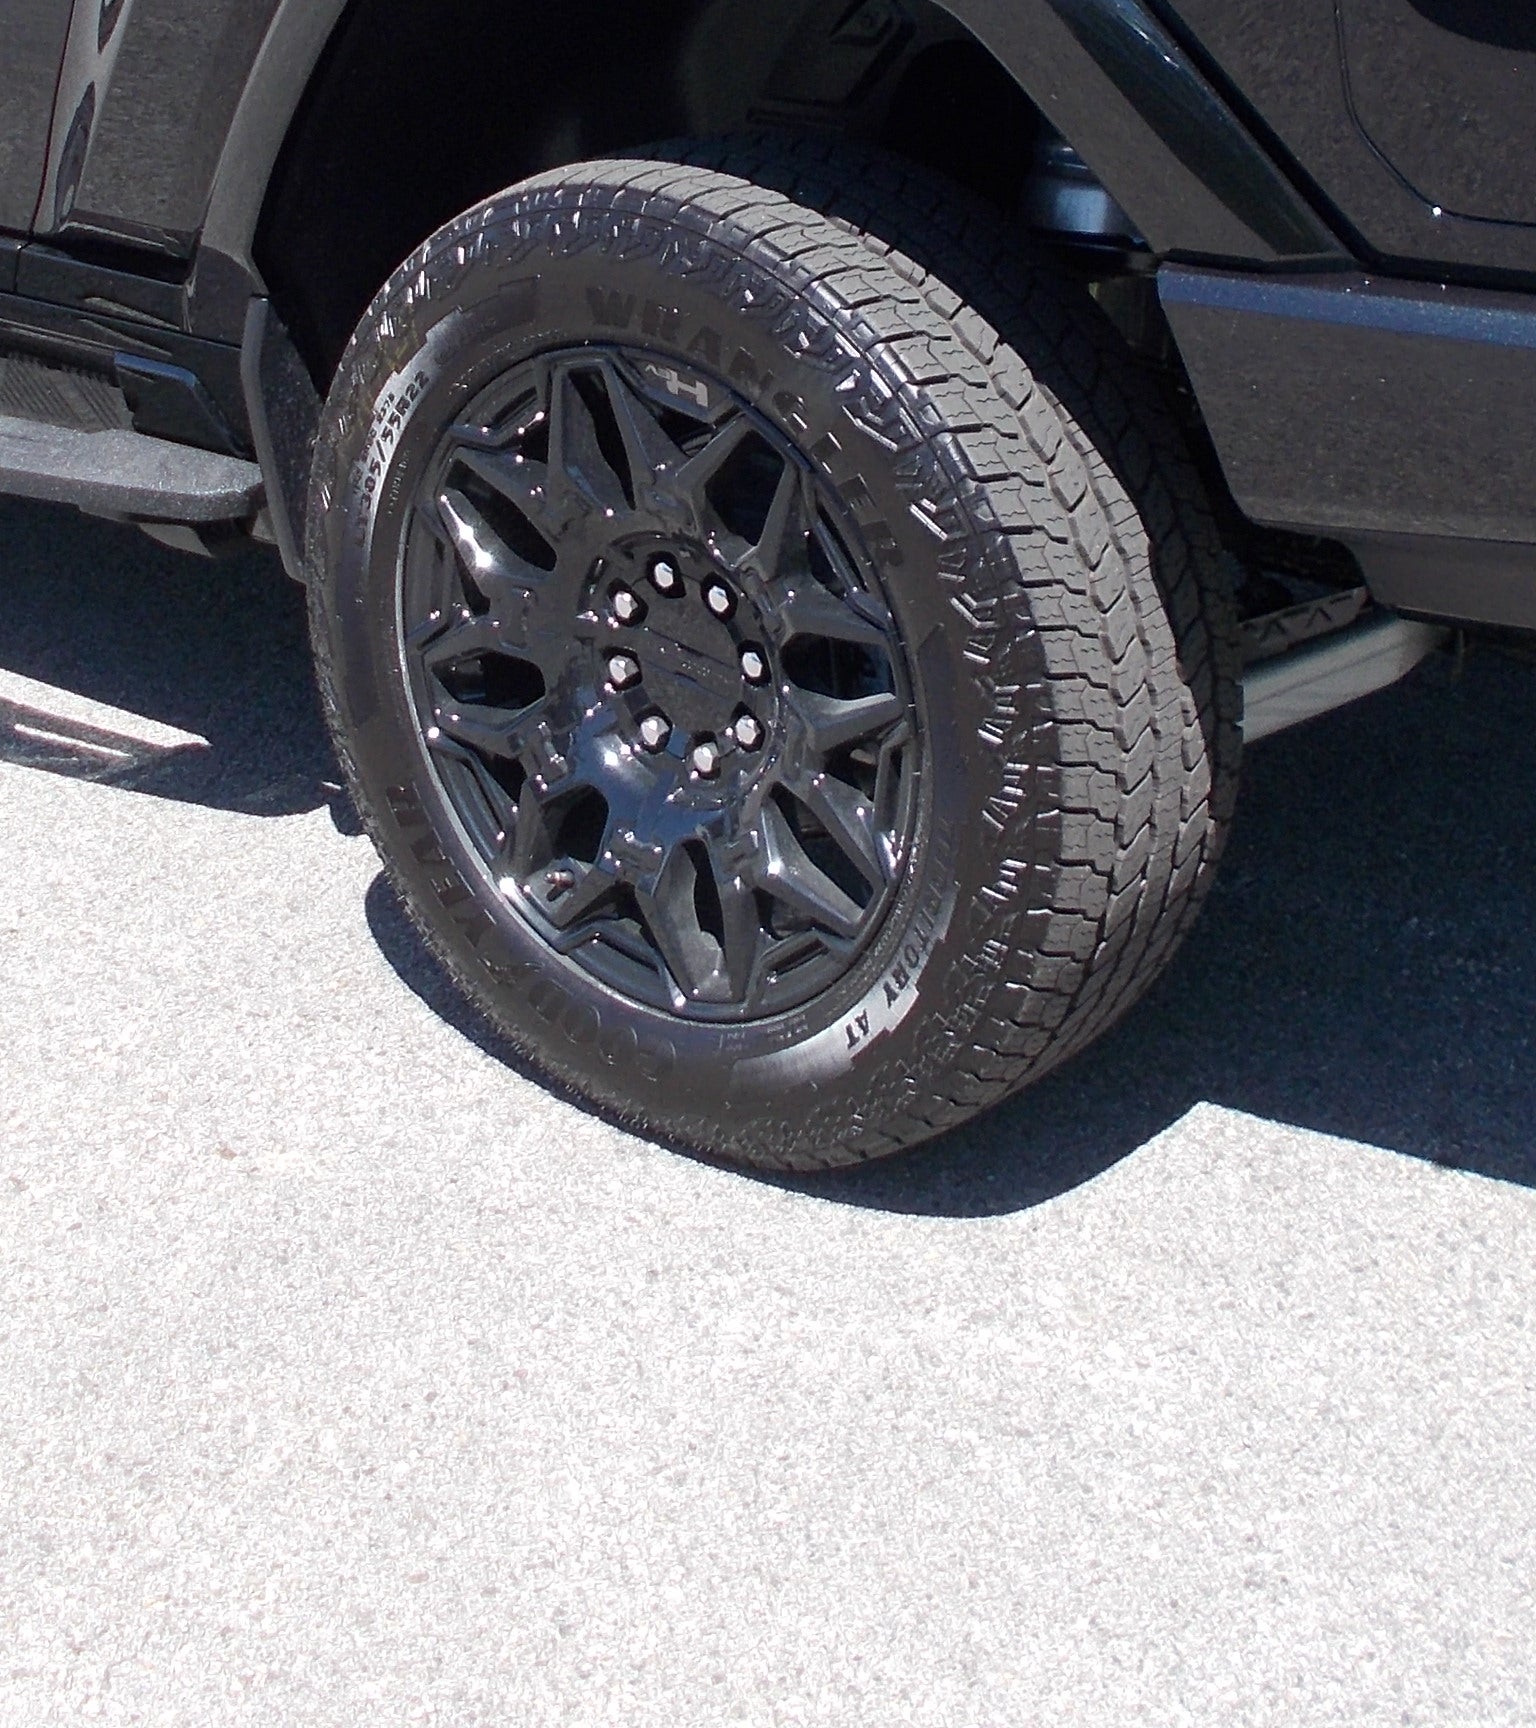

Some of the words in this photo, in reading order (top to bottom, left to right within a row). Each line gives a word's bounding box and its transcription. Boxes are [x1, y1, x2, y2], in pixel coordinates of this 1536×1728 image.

[585, 286, 905, 567] WRANGLER
[386, 780, 677, 1082] GOODYEAR
[846, 1008, 871, 1050] AT
